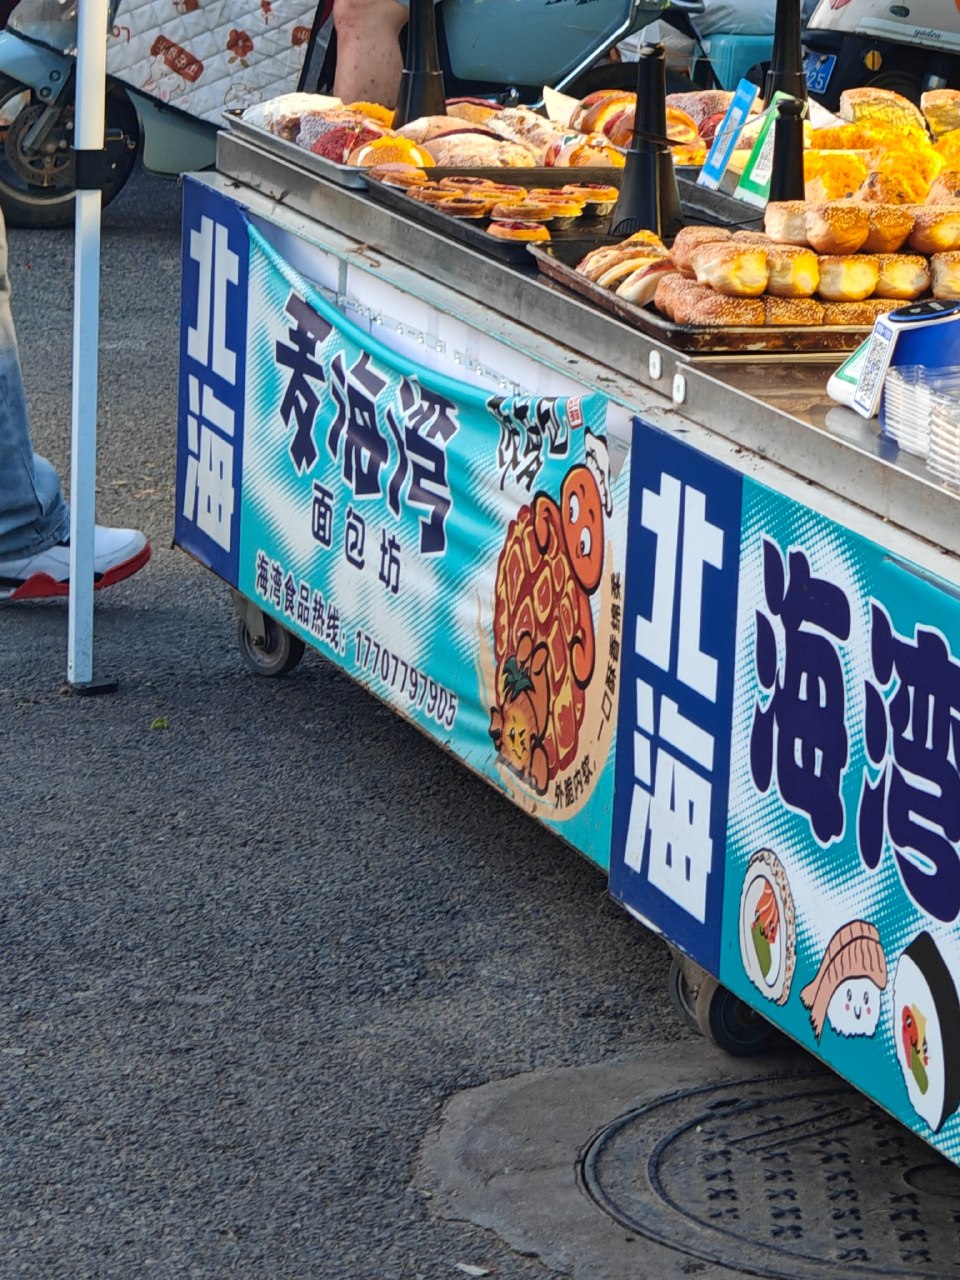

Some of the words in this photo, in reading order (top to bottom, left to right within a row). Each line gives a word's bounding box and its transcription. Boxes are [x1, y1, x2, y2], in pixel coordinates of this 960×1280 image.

[183, 214, 240, 553] 北海
[275, 291, 459, 555] 麦海湾
[256, 555, 347, 654] 海湾食品热线：
[356, 630, 457, 727] 17707797905
[311, 481, 401, 595] 面包坊
[624, 471, 725, 924] 北海
